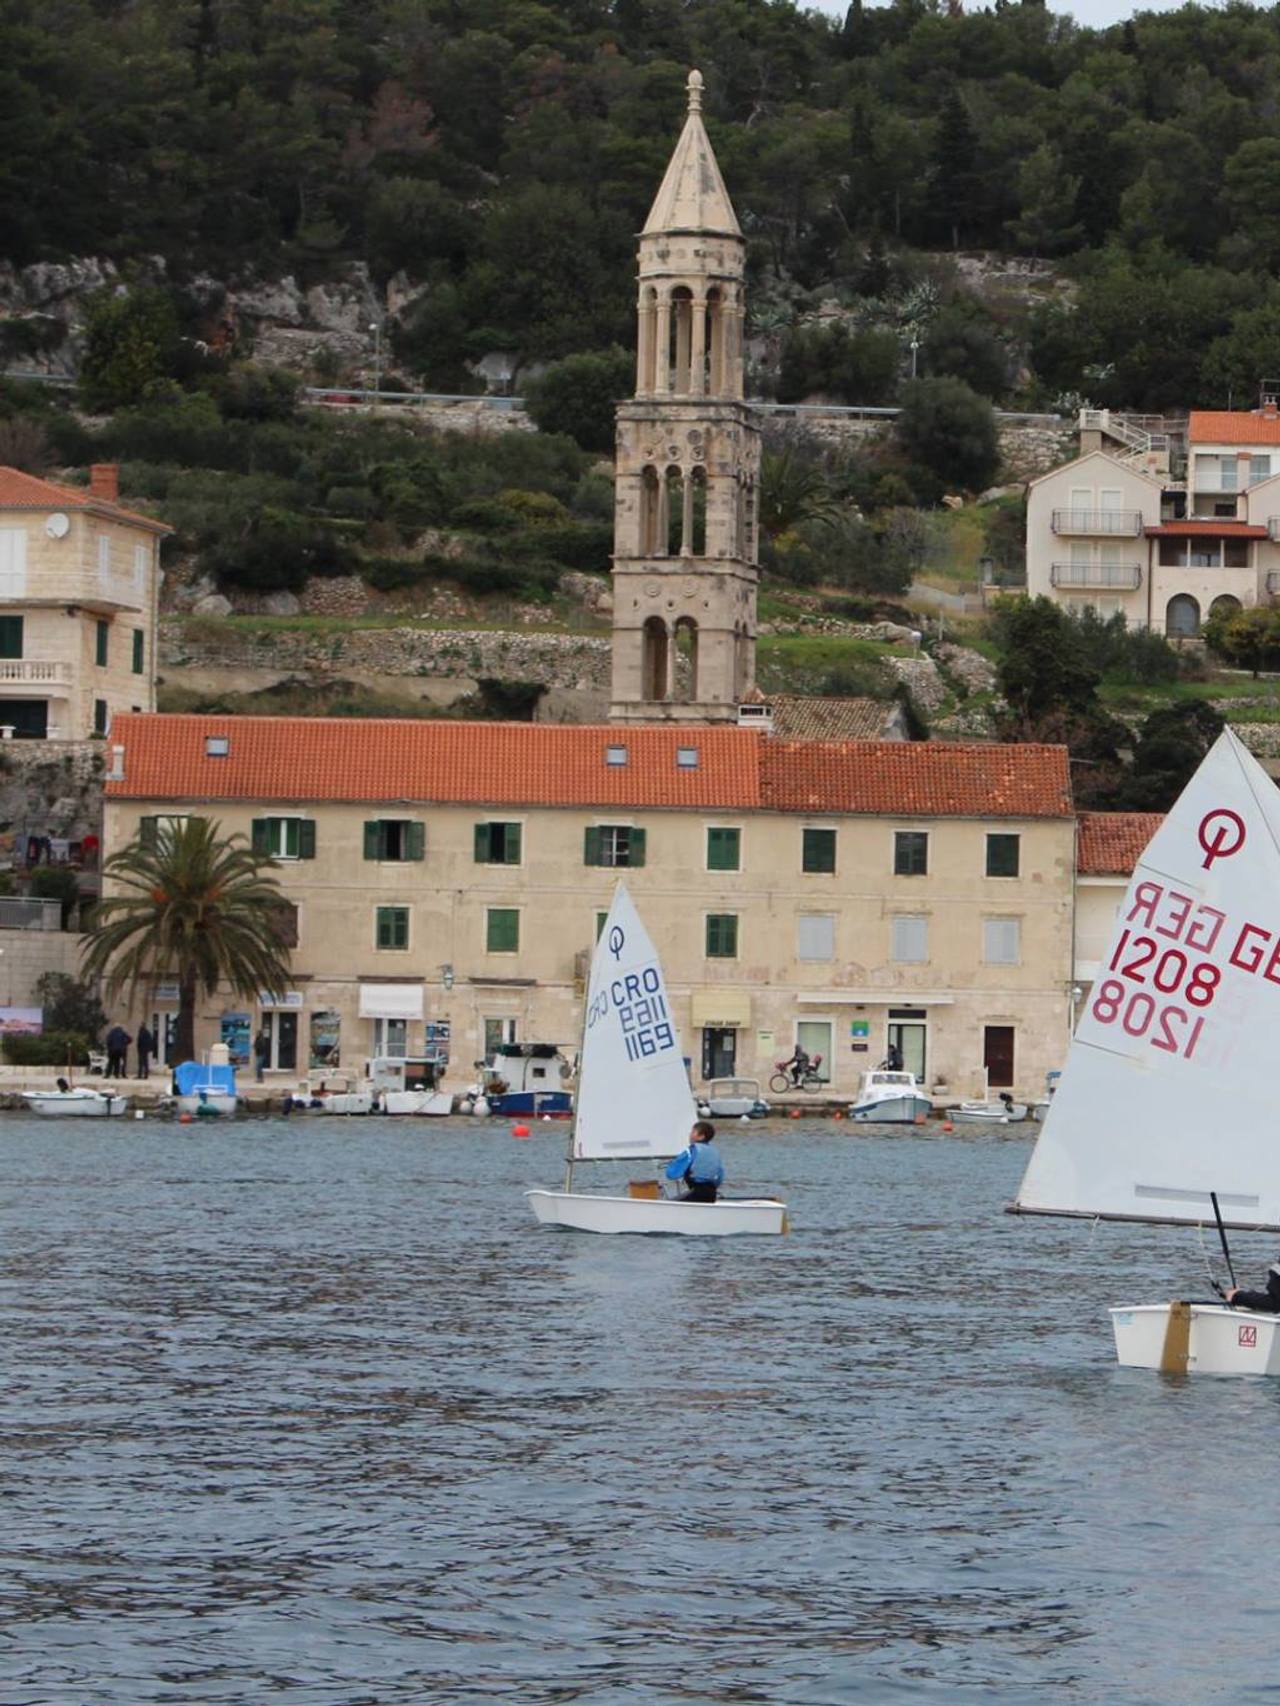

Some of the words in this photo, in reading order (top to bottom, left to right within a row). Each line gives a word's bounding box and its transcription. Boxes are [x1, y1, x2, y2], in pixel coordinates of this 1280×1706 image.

[611, 968, 660, 1006] CRO
[1109, 929, 1222, 1007] 1208
[624, 1022, 675, 1062] 1169
